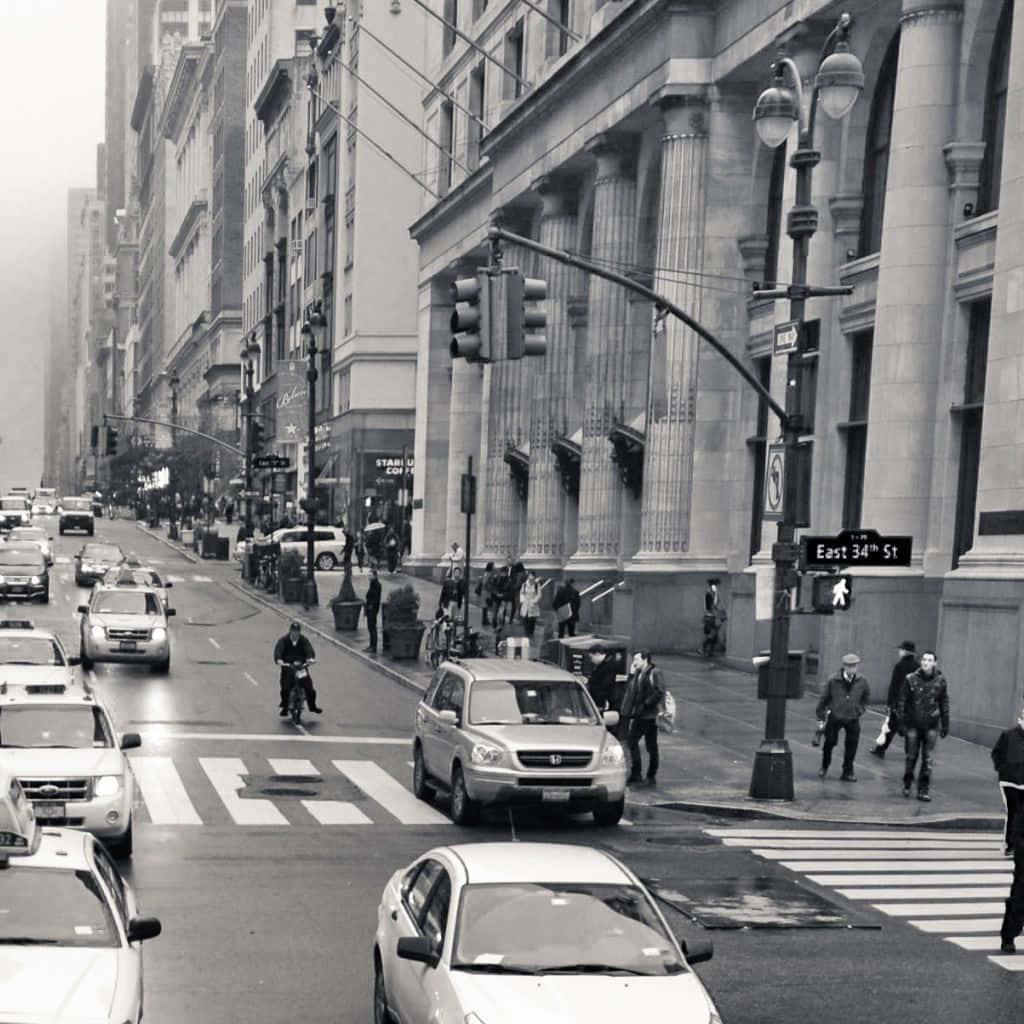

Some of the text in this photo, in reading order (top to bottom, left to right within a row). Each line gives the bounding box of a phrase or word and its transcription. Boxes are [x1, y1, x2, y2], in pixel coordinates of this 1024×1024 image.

[816, 543, 898, 559] East 34th St
